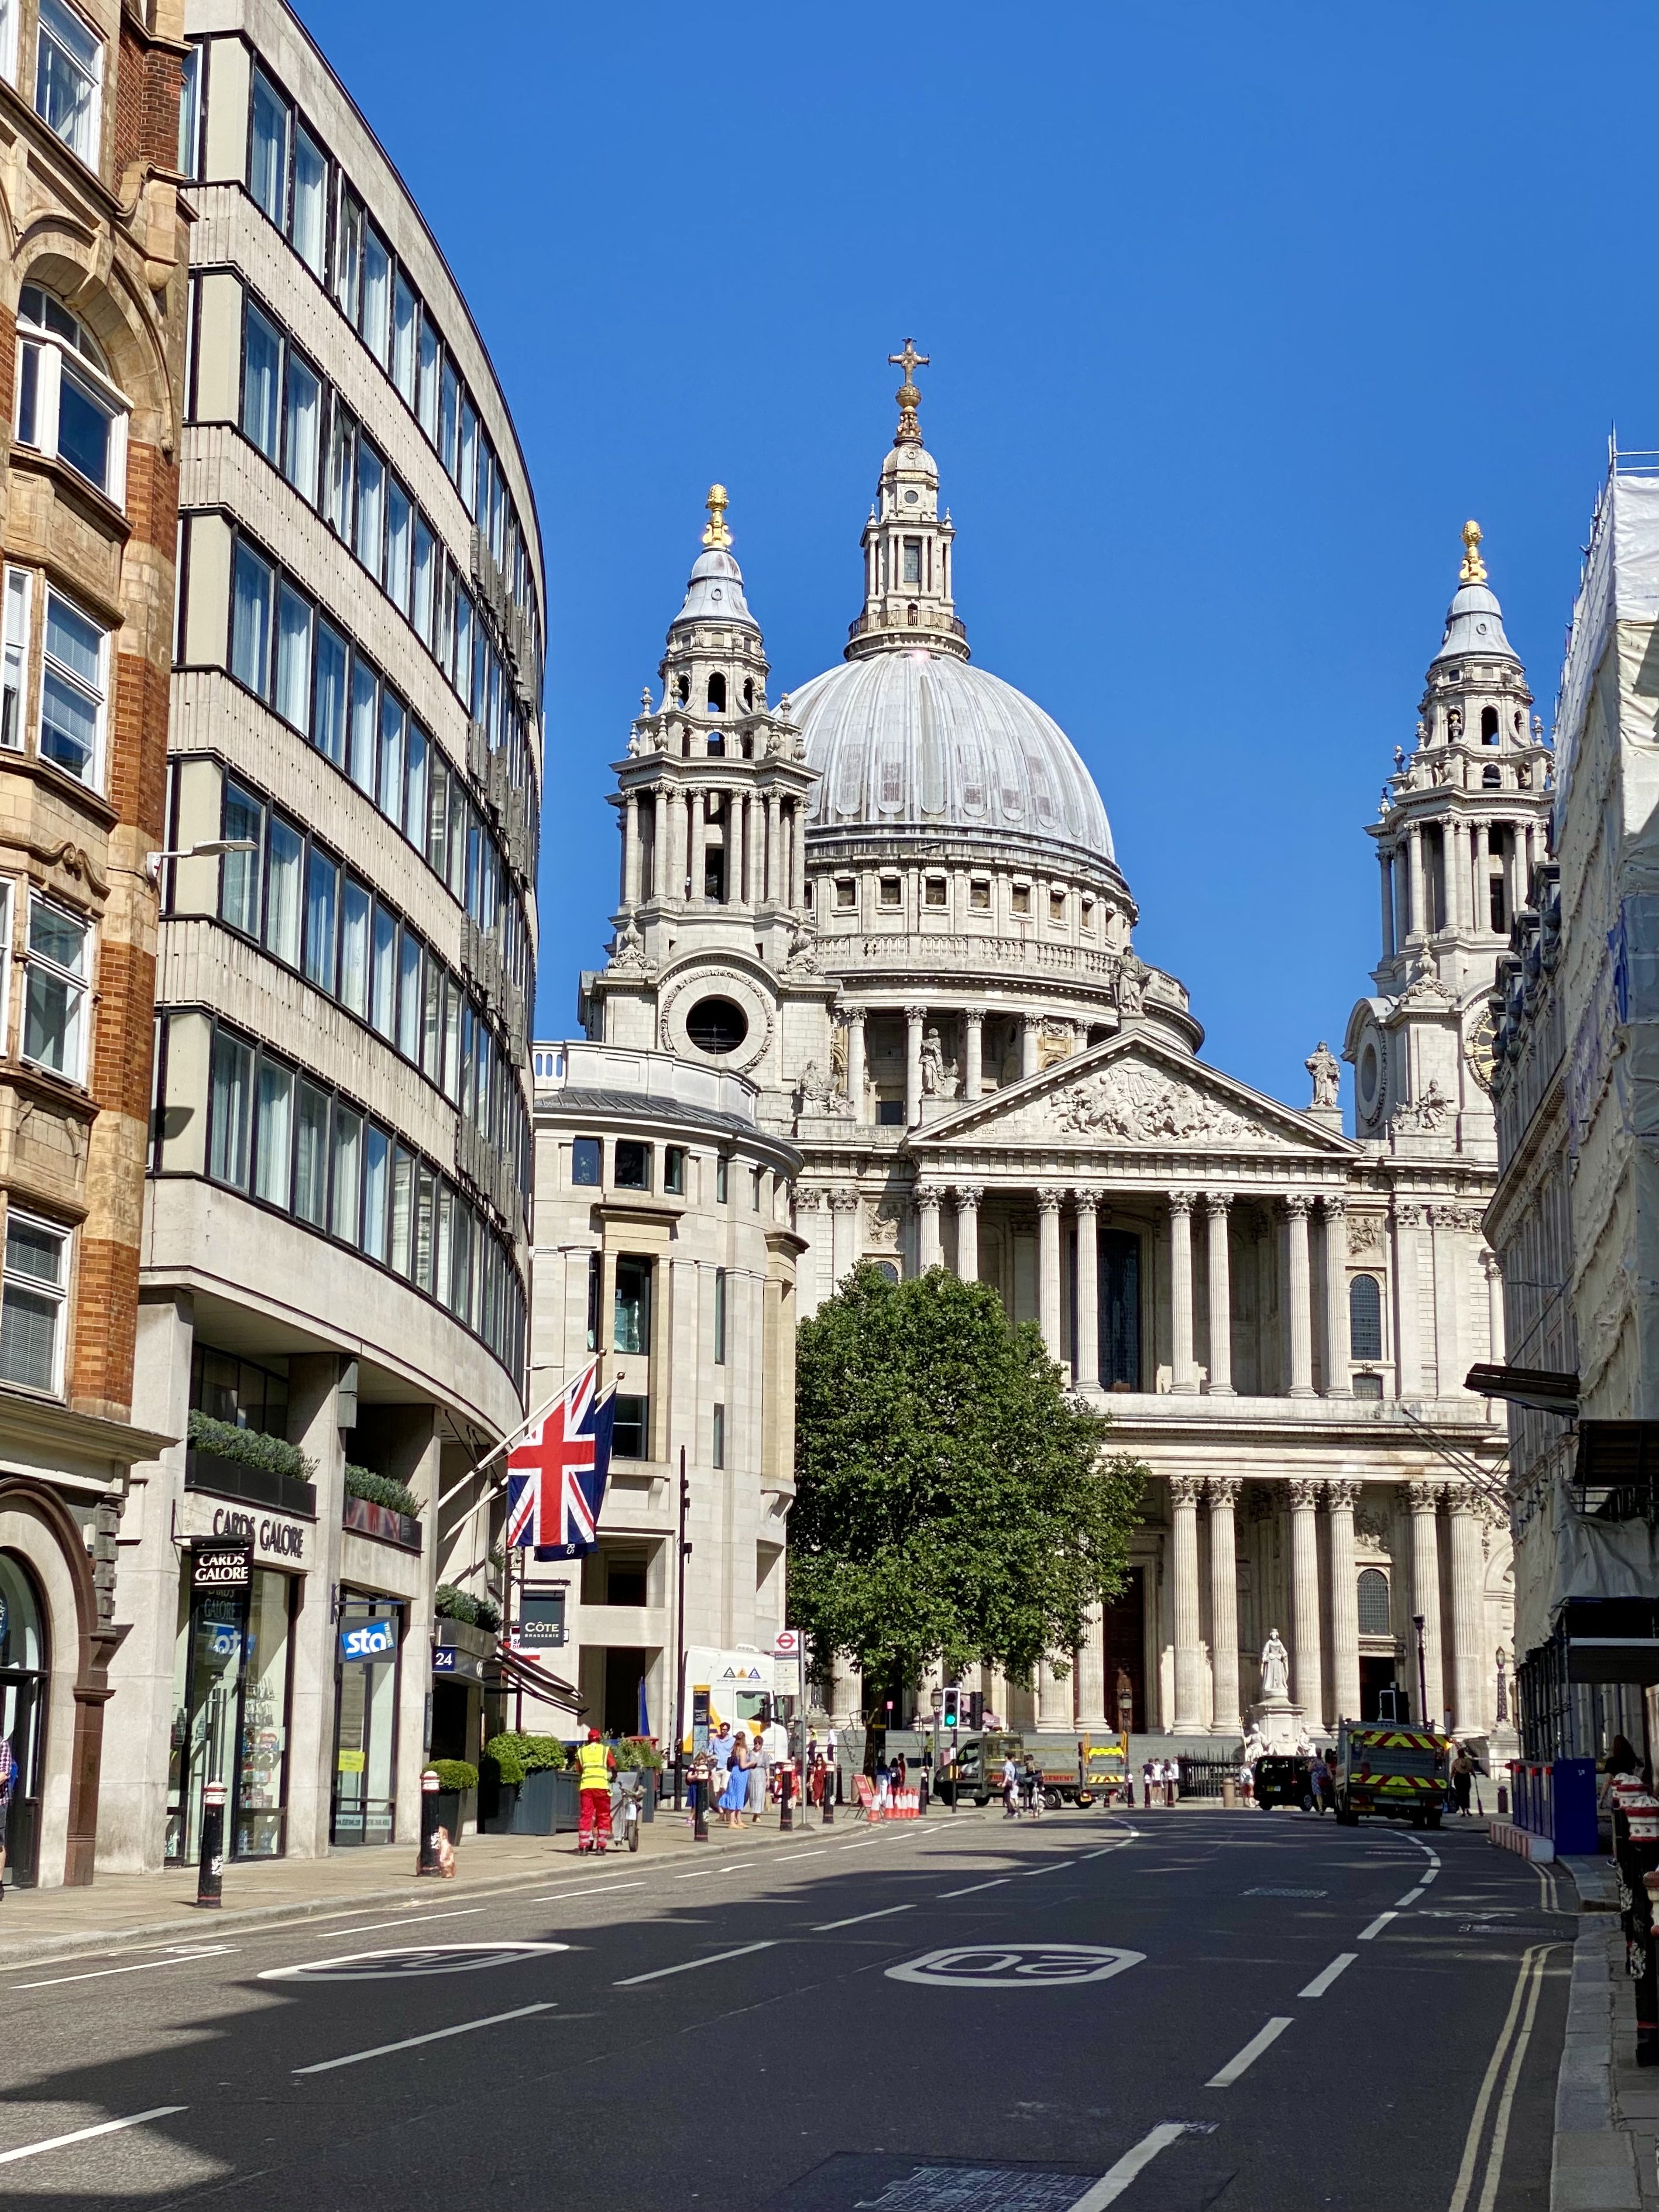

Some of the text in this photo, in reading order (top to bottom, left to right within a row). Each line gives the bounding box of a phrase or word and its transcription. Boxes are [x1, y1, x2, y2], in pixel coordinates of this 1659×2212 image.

[213, 1508, 304, 1558] CARDS GALORE
[199, 1553, 245, 1567] CARDS
[195, 1567, 249, 1581] GALORE
[383, 1621, 394, 1647] TRAVEL
[525, 1622, 559, 1632] CÔTE
[346, 1628, 387, 1653] sta
[435, 1653, 453, 1666] 24
[307, 1952, 518, 1969] 20
[926, 1953, 1115, 1974] 20
